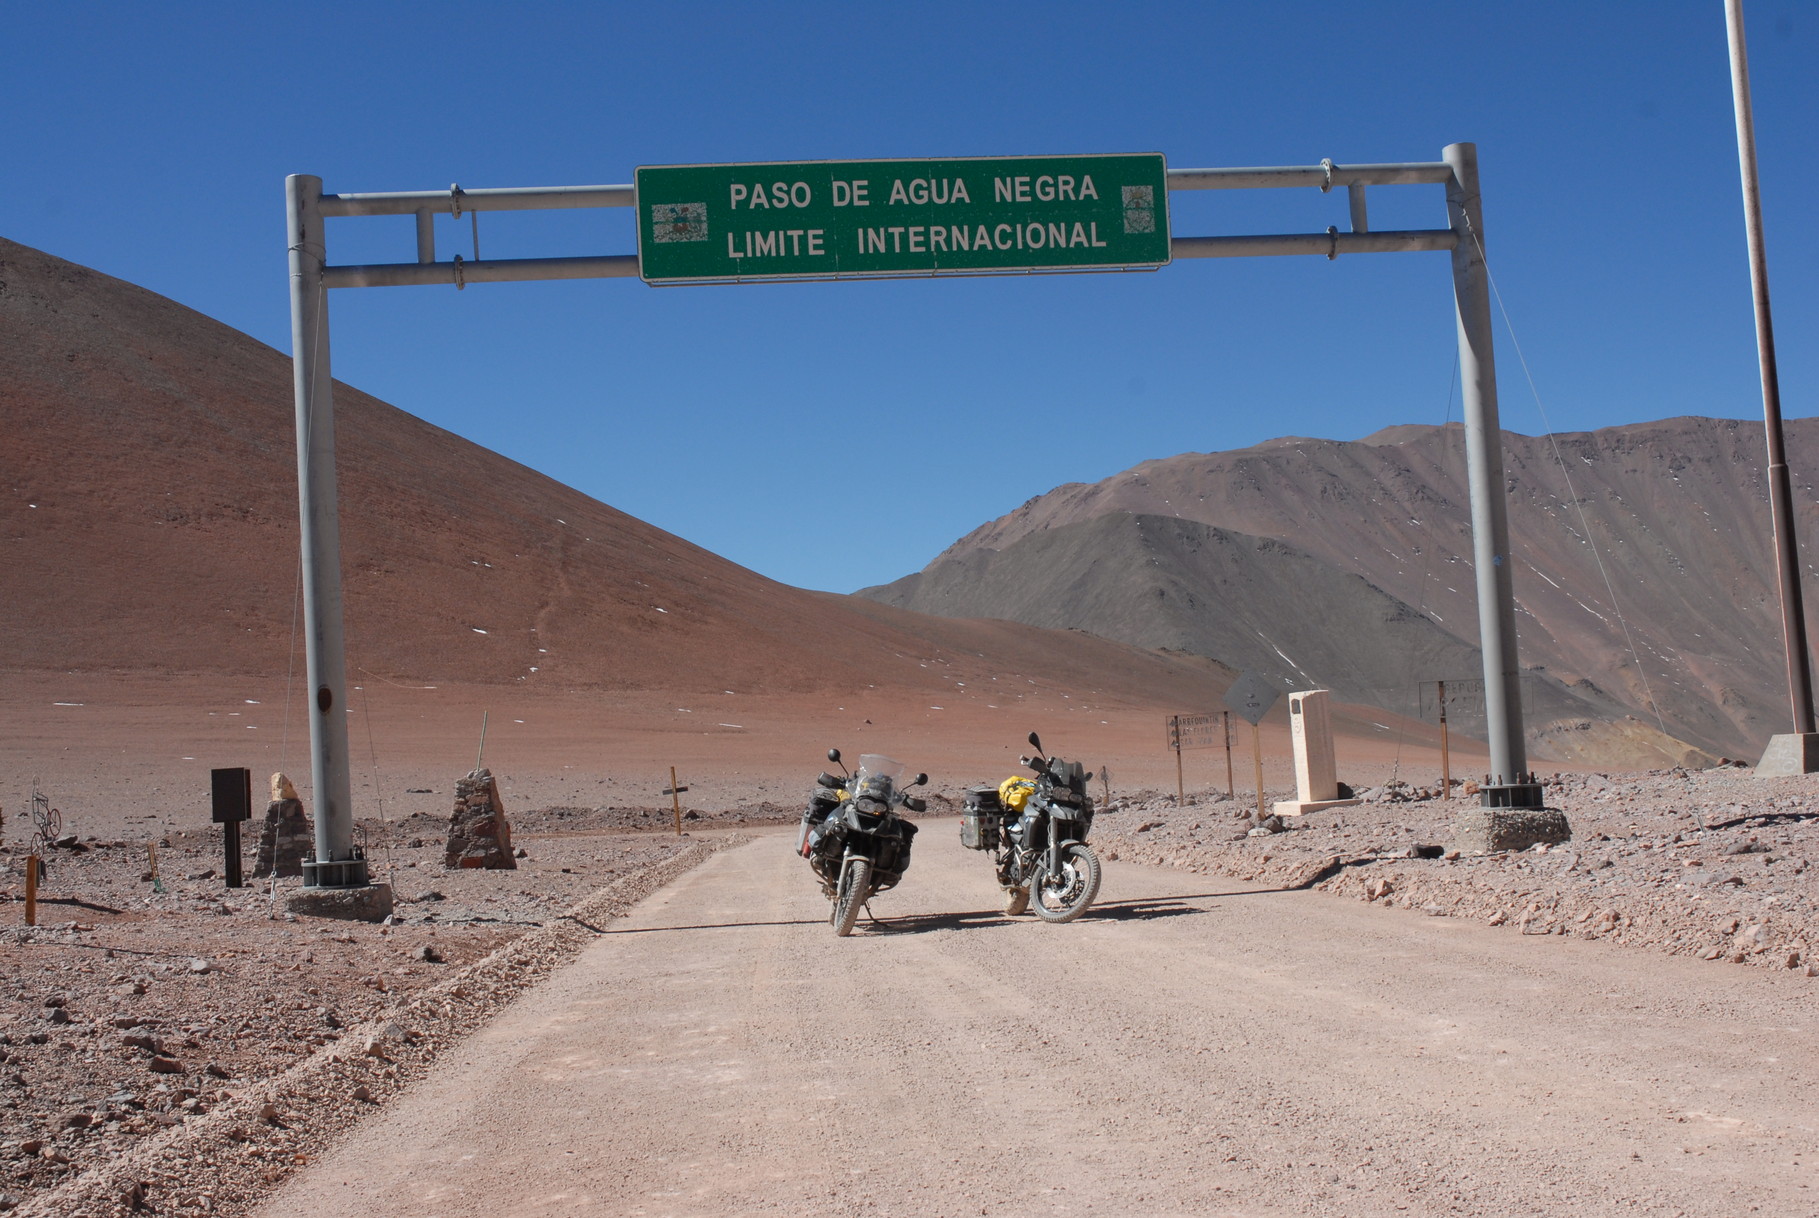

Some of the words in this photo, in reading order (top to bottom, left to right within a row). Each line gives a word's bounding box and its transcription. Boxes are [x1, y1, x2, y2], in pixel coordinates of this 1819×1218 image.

[730, 181, 811, 209] PASO
[832, 180, 870, 207] DE
[889, 178, 970, 205] AGUA
[994, 174, 1098, 202] NEGRA
[727, 229, 825, 258] LIMITE
[857, 221, 1107, 254] INTERNACIONAL
